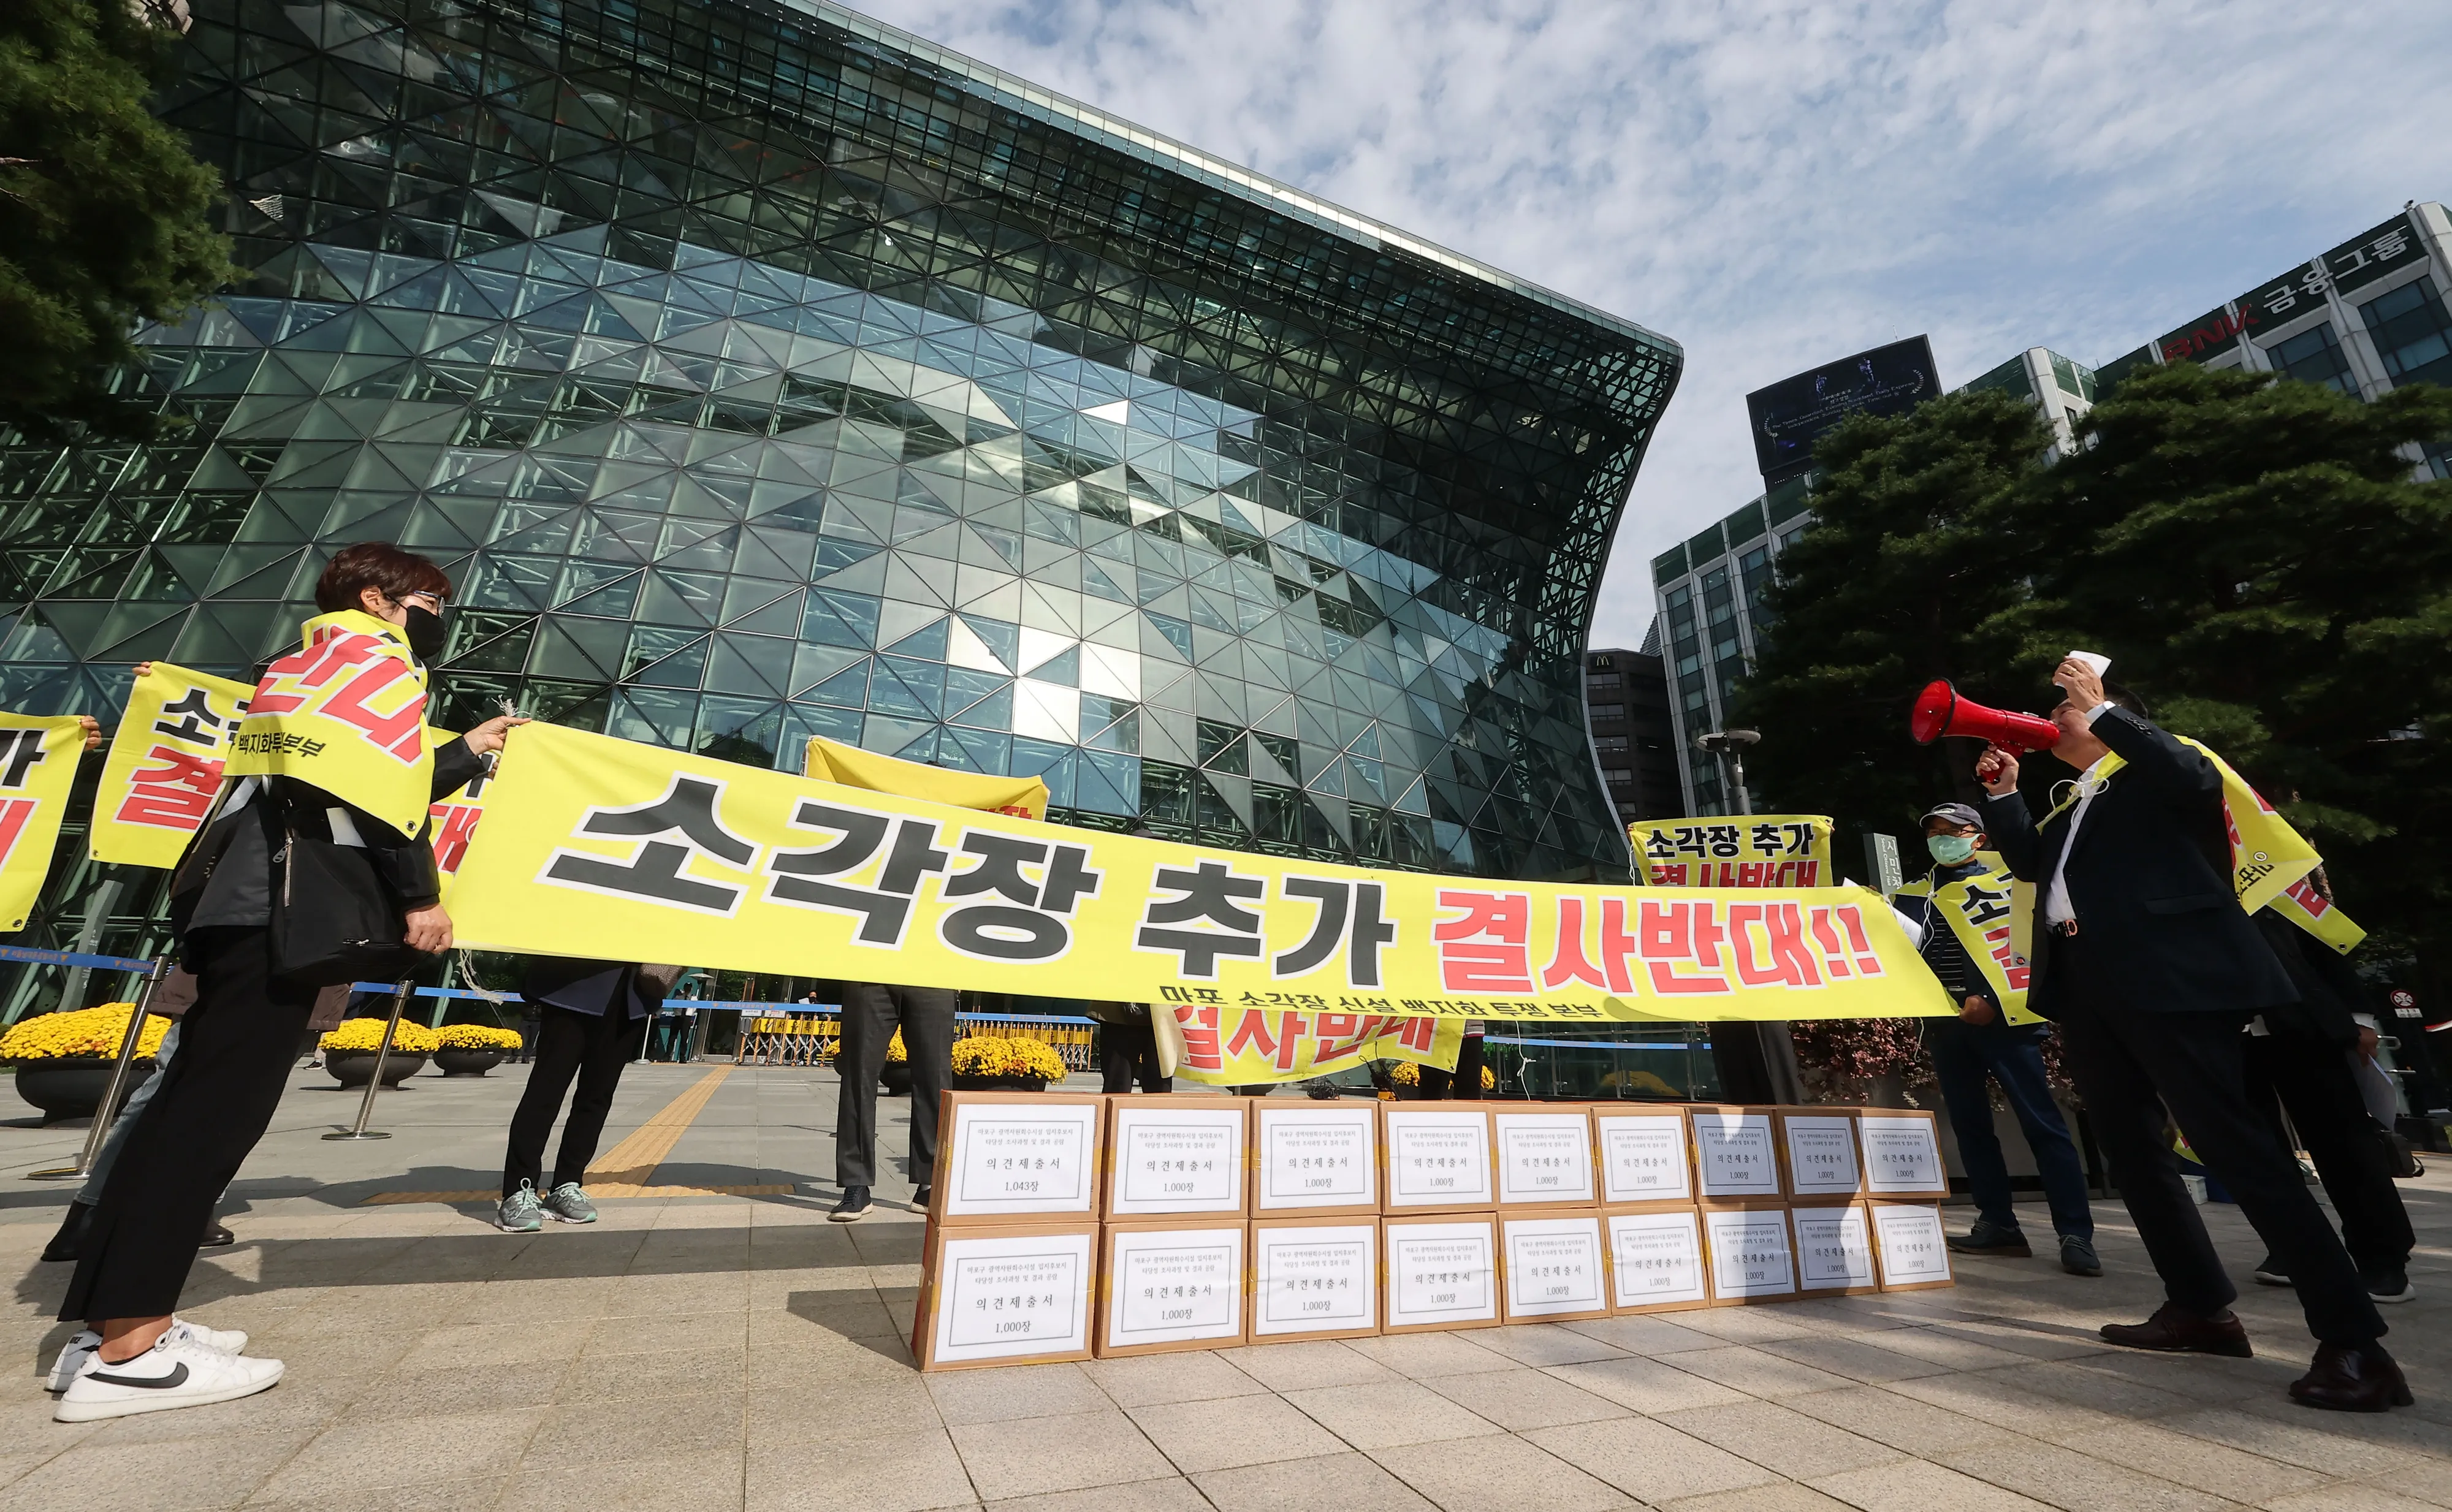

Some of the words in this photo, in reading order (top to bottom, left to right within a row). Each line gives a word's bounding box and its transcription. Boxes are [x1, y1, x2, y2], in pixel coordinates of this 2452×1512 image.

[2163, 304, 2260, 361] BNK
[2263, 224, 2409, 314] 금융그룹
[1646, 824, 1740, 858] 소각장
[1751, 822, 1814, 857] 추가
[546, 777, 1099, 959] 소각장
[1137, 862, 1394, 986] 추가
[1434, 890, 1882, 993] 결사반대!!
[1159, 986, 1228, 1005] 마포
[1239, 991, 1330, 1010] 소각장
[1339, 996, 1399, 1013] 신설
[1399, 999, 1490, 1016] 백지화
[1490, 1002, 1550, 1017] 투쟁
[1548, 1003, 1604, 1018] 본부
[777, 1020, 840, 1035] 서울특별시
[1536, 1176, 1558, 1185] 1,000장
[1637, 1175, 1658, 1185] 1,000장
[1729, 1171, 1749, 1180] 1,000장
[1818, 1171, 1835, 1179] 1,000장
[1005, 1180, 1039, 1193] 1,043장
[1164, 1182, 1194, 1193] 1,000장
[1305, 1177, 1332, 1188] 1,000장
[1430, 1177, 1455, 1187] 1,000장
[1827, 1264, 1846, 1274] 1,000장
[1908, 1259, 1925, 1268] 1,000장
[1745, 1271, 1765, 1280] 1,000장
[1649, 1277, 1670, 1287] 1,000장
[1546, 1285, 1569, 1296] 1,000장
[1431, 1293, 1456, 1304] 1,000장
[1303, 1300, 1331, 1312] 1,000장
[1162, 1308, 1193, 1320] 1,000장
[996, 1320, 1031, 1334] 1,000장
